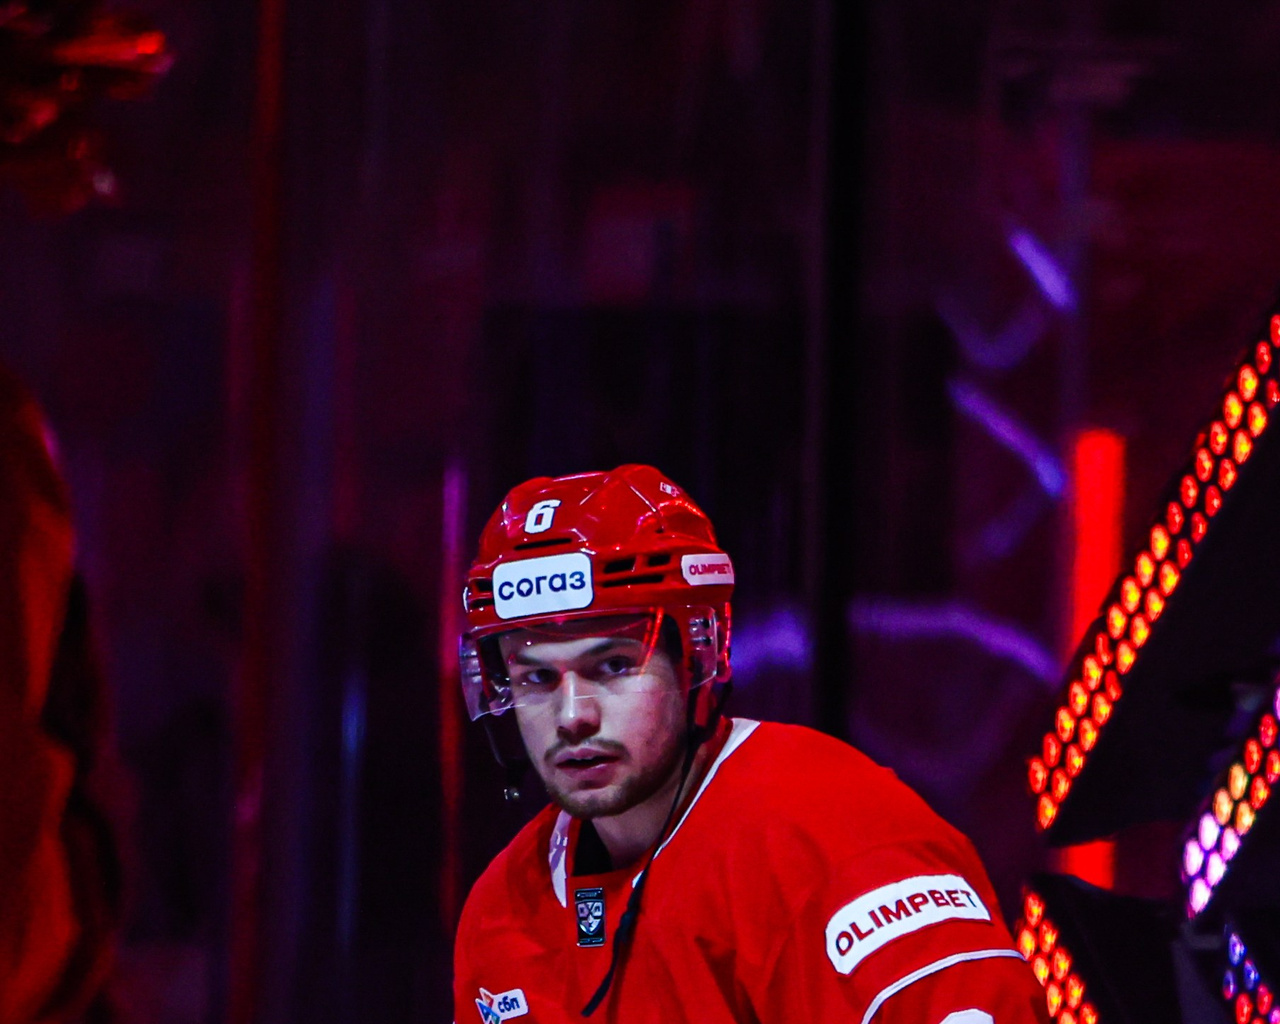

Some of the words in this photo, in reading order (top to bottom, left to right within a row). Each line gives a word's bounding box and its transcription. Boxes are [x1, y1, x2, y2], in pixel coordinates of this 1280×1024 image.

[525, 499, 562, 534] 6
[498, 571, 586, 601] согаз
[836, 889, 977, 957] OLIMPBET
